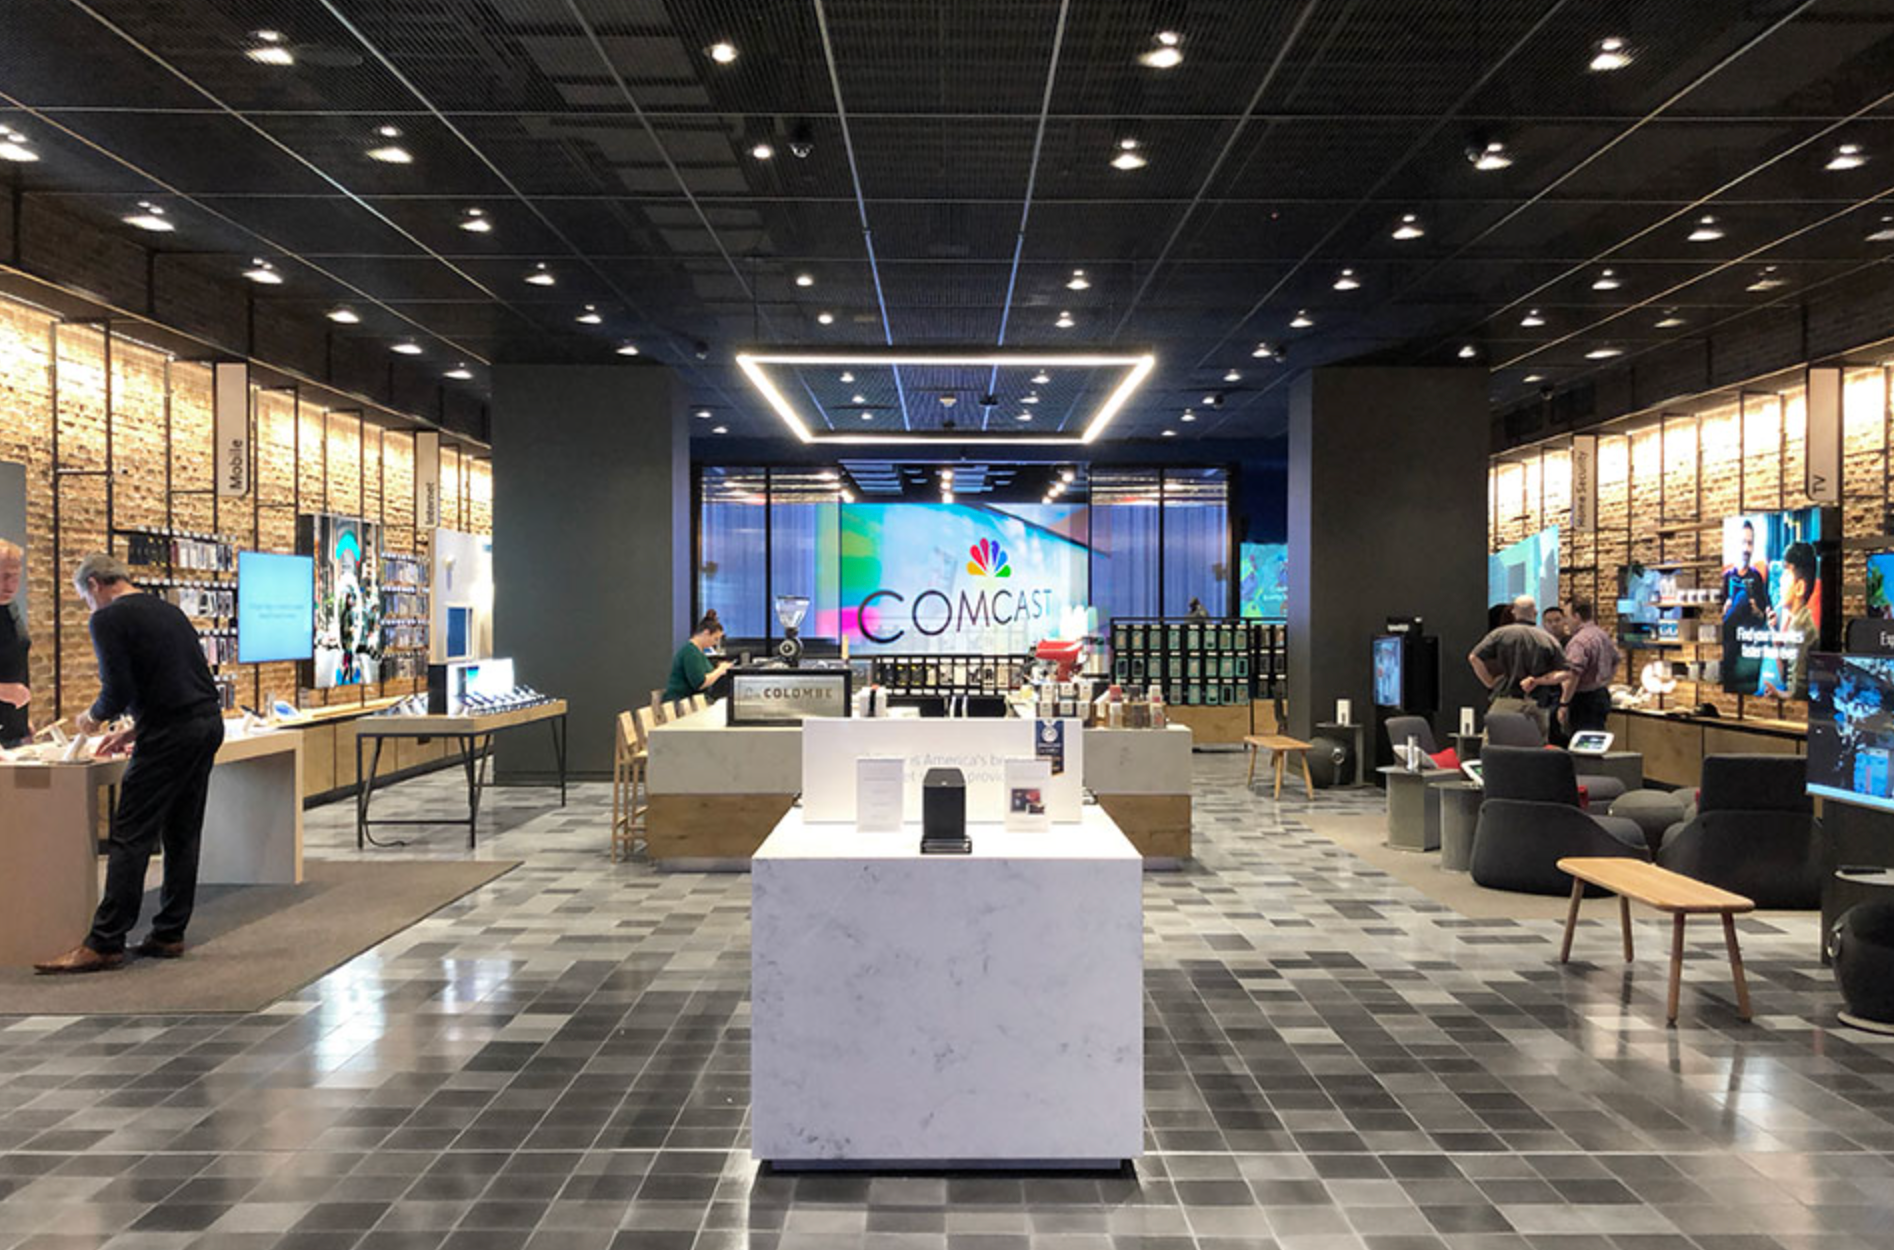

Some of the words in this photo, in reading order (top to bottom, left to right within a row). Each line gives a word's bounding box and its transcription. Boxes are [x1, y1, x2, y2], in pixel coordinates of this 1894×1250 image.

[229, 439, 243, 490] Mobile
[1812, 474, 1827, 495] TV
[425, 481, 435, 526] Internet
[857, 589, 1053, 644] COMCAST
[763, 687, 833, 699] COLOMBE
[923, 753, 987, 767] America's
